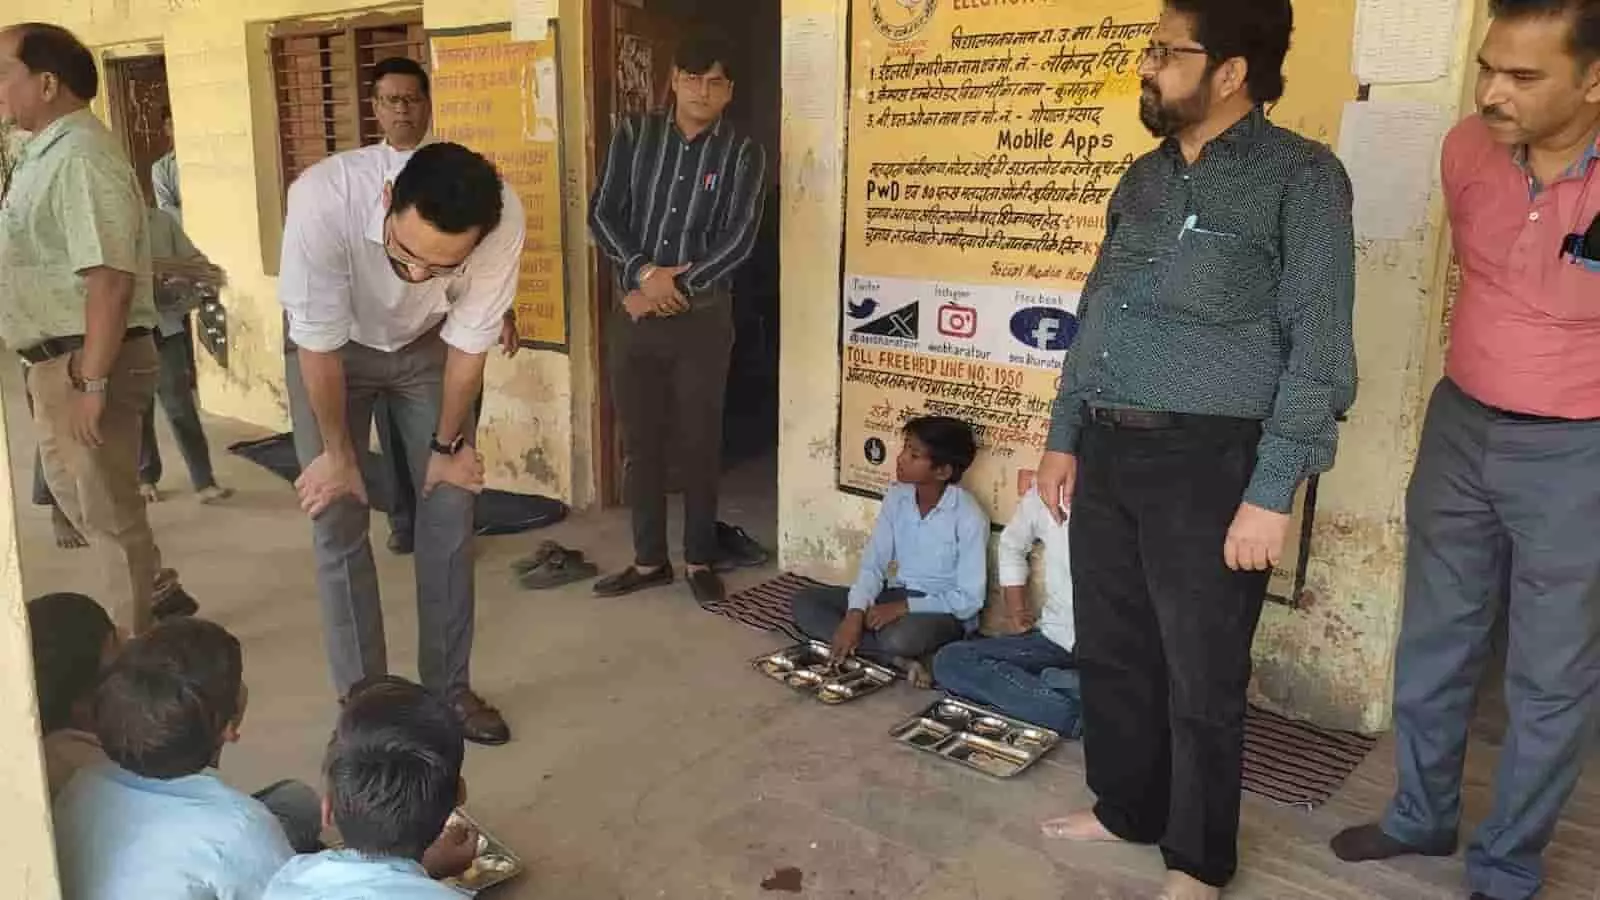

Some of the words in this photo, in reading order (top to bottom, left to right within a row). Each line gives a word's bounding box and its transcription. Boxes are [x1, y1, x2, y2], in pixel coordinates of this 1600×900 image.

[953, 0, 1034, 10] ELEC
[998, 128, 1054, 150] Mobile
[1061, 128, 1113, 156] Apps
[867, 180, 900, 201] PwD
[848, 345, 874, 364] TOLL
[879, 351, 911, 370] FREE
[912, 356, 936, 372] HELP
[940, 358, 965, 377] LINE
[994, 368, 1023, 388] 1950
